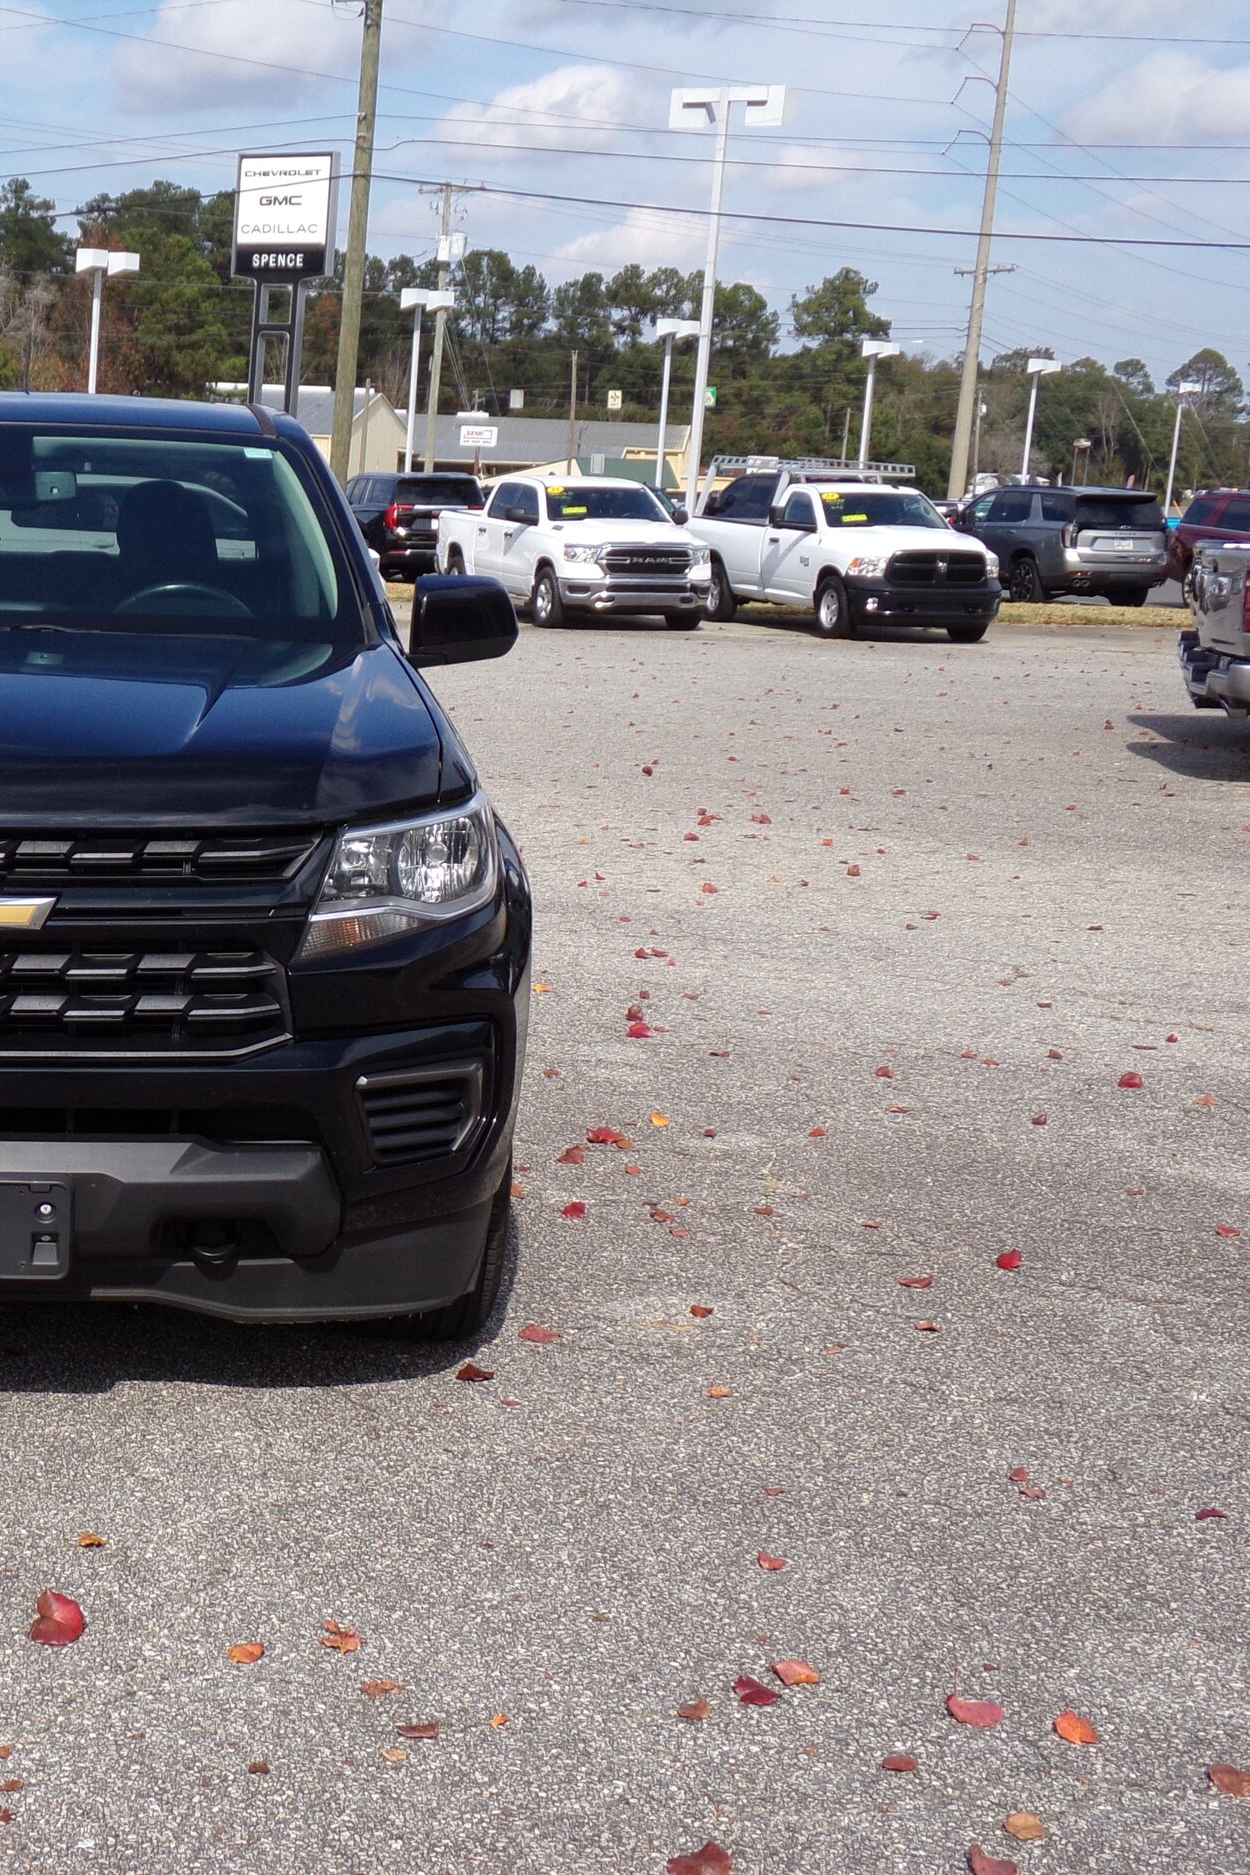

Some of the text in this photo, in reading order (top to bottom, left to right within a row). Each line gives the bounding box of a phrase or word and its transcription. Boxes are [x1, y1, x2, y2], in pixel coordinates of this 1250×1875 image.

[244, 169, 322, 177] CHEVROLET
[259, 194, 303, 206] GMC
[240, 223, 318, 234] CADILLAC
[251, 253, 304, 268] SPENCE
